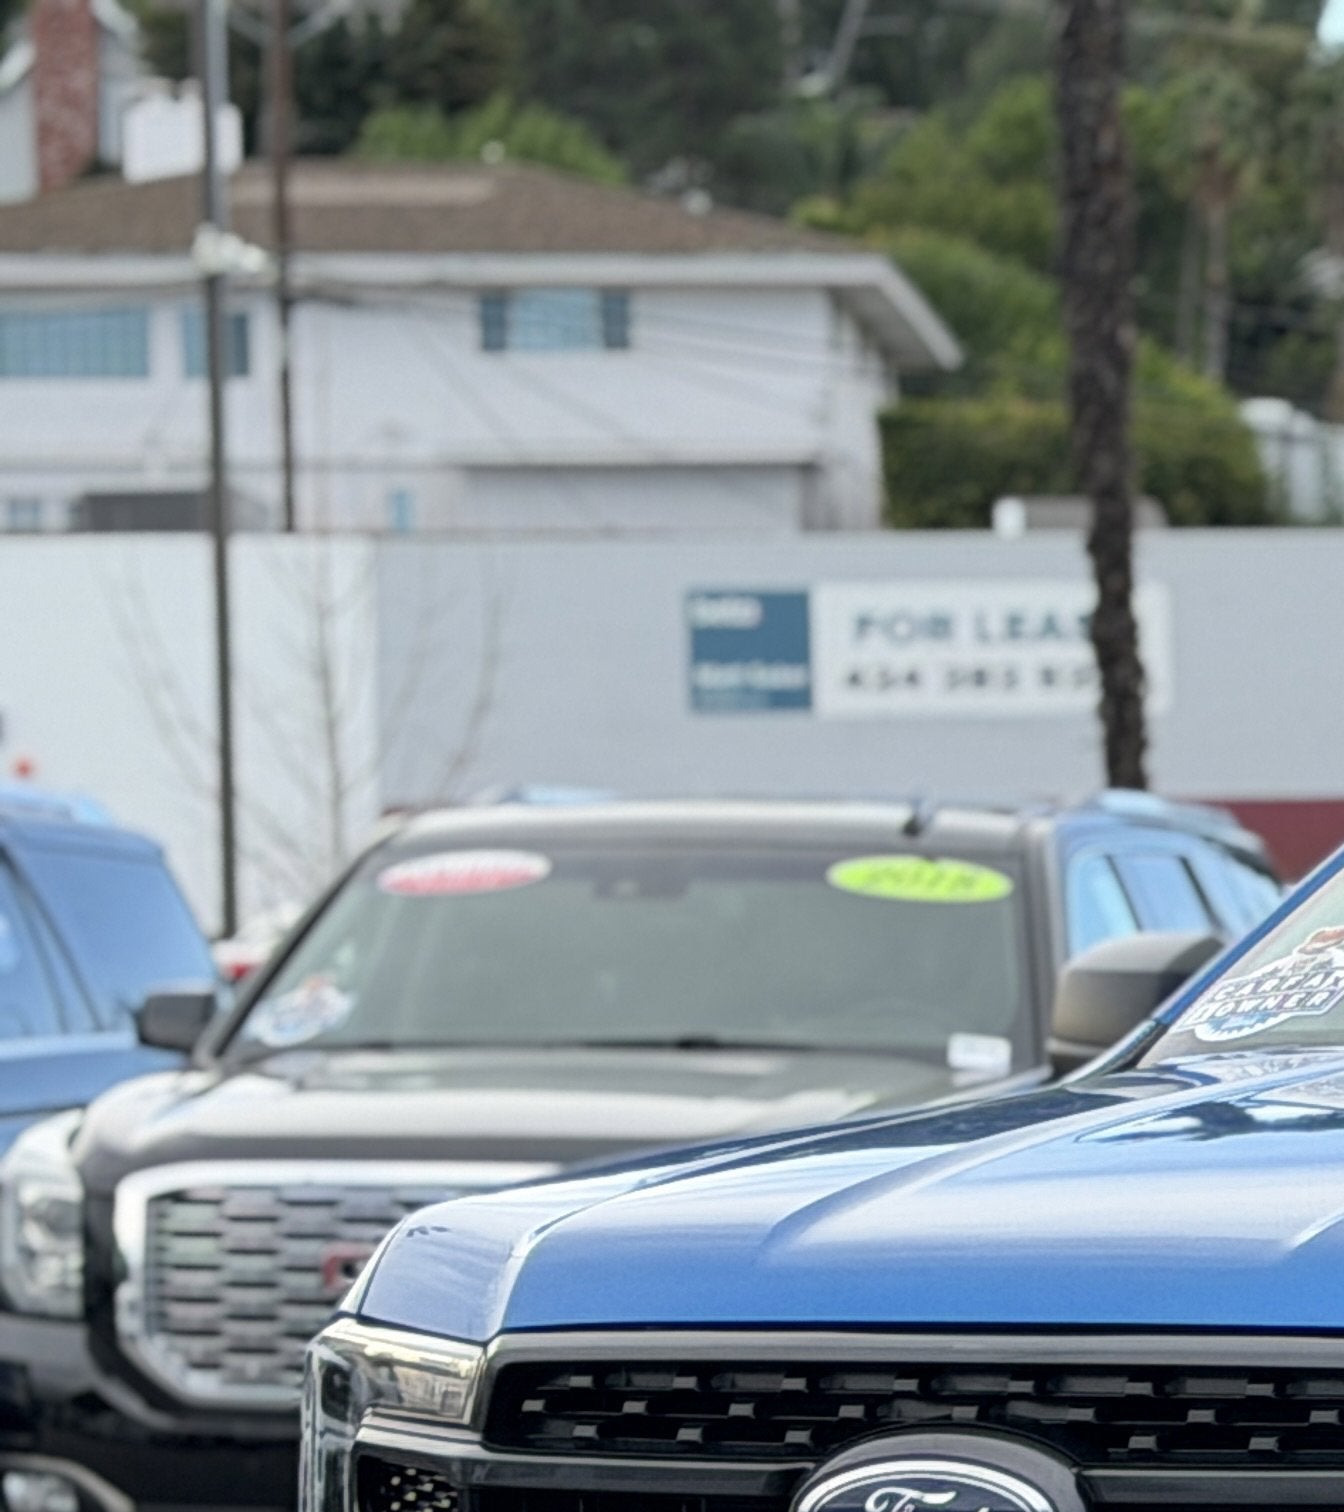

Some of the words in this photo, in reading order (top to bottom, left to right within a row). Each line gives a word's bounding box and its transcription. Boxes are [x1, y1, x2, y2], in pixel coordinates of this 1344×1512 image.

[854, 611, 954, 645] FOR
[974, 611, 1096, 644] LEA
[1213, 991, 1332, 1017] OWNER
